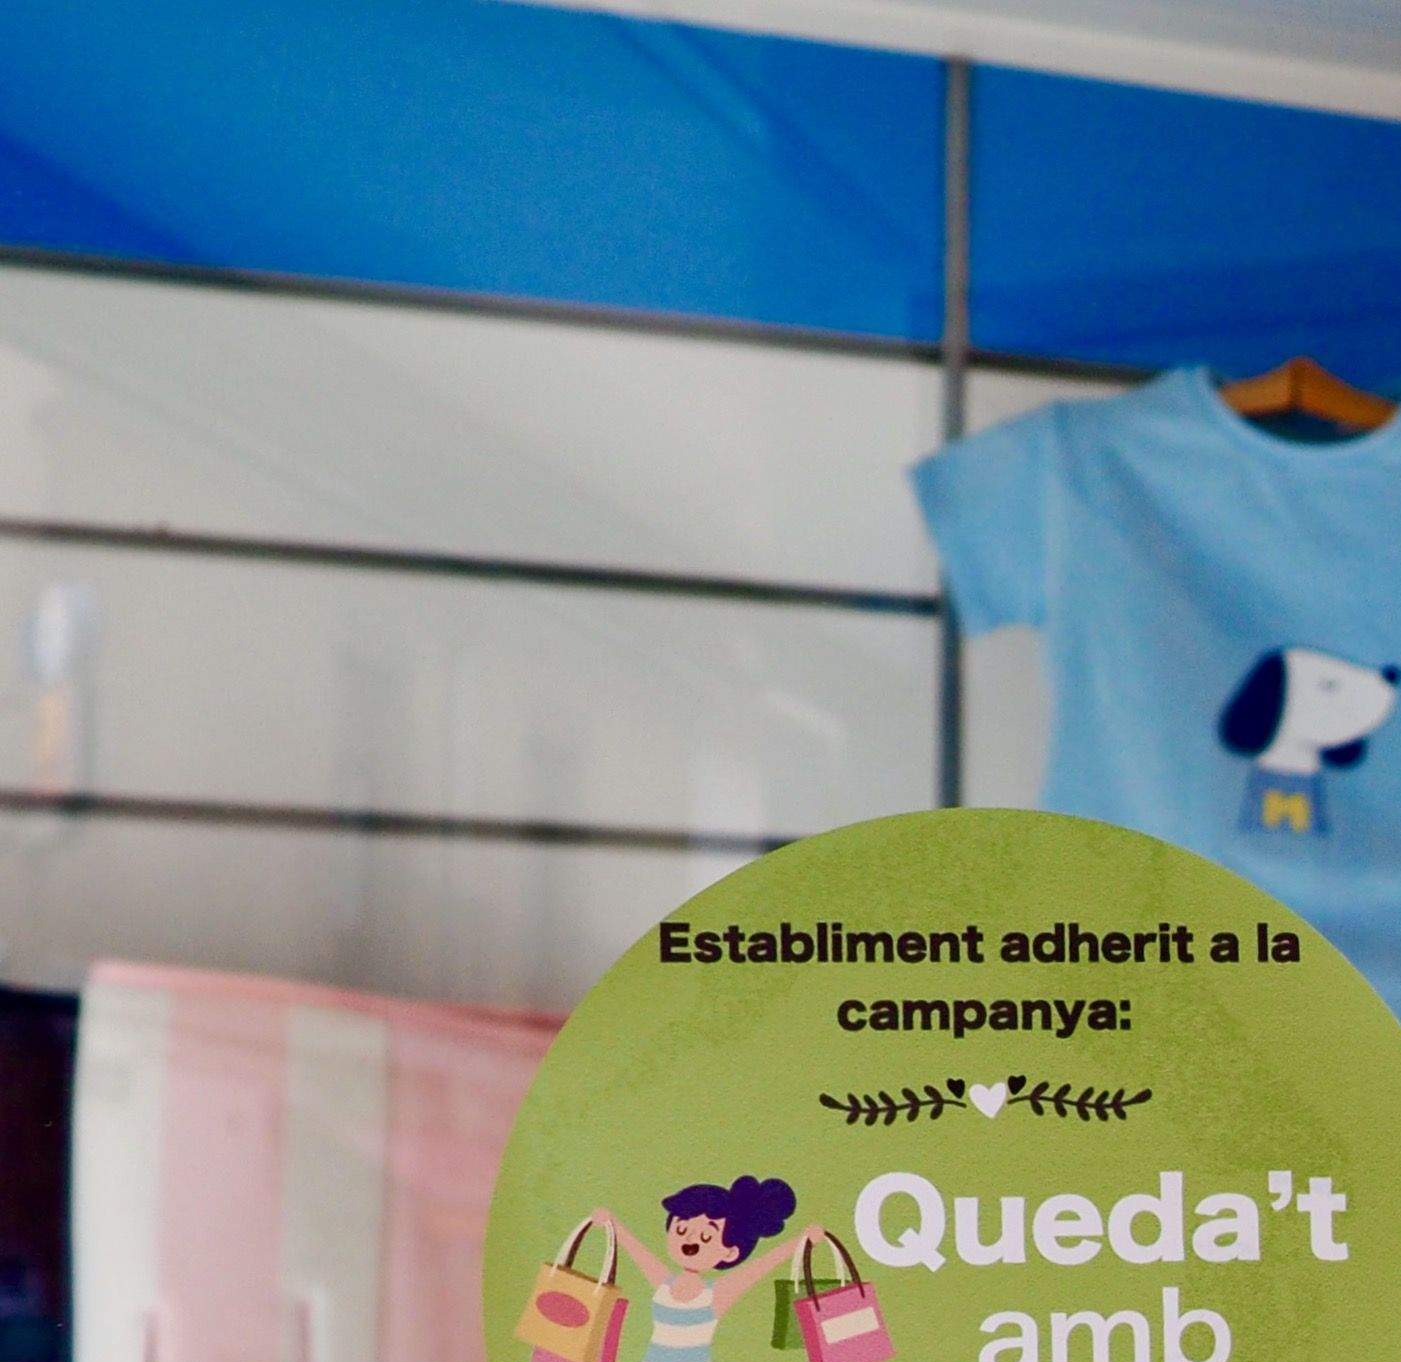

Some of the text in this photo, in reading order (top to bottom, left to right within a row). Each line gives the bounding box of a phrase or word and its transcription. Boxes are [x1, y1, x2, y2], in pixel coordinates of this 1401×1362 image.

[1262, 790, 1311, 834] M
[659, 922, 1301, 964] Establiment adherit a la
[837, 998, 1132, 1039] campanya:
[854, 1170, 1349, 1272] Queda’t
